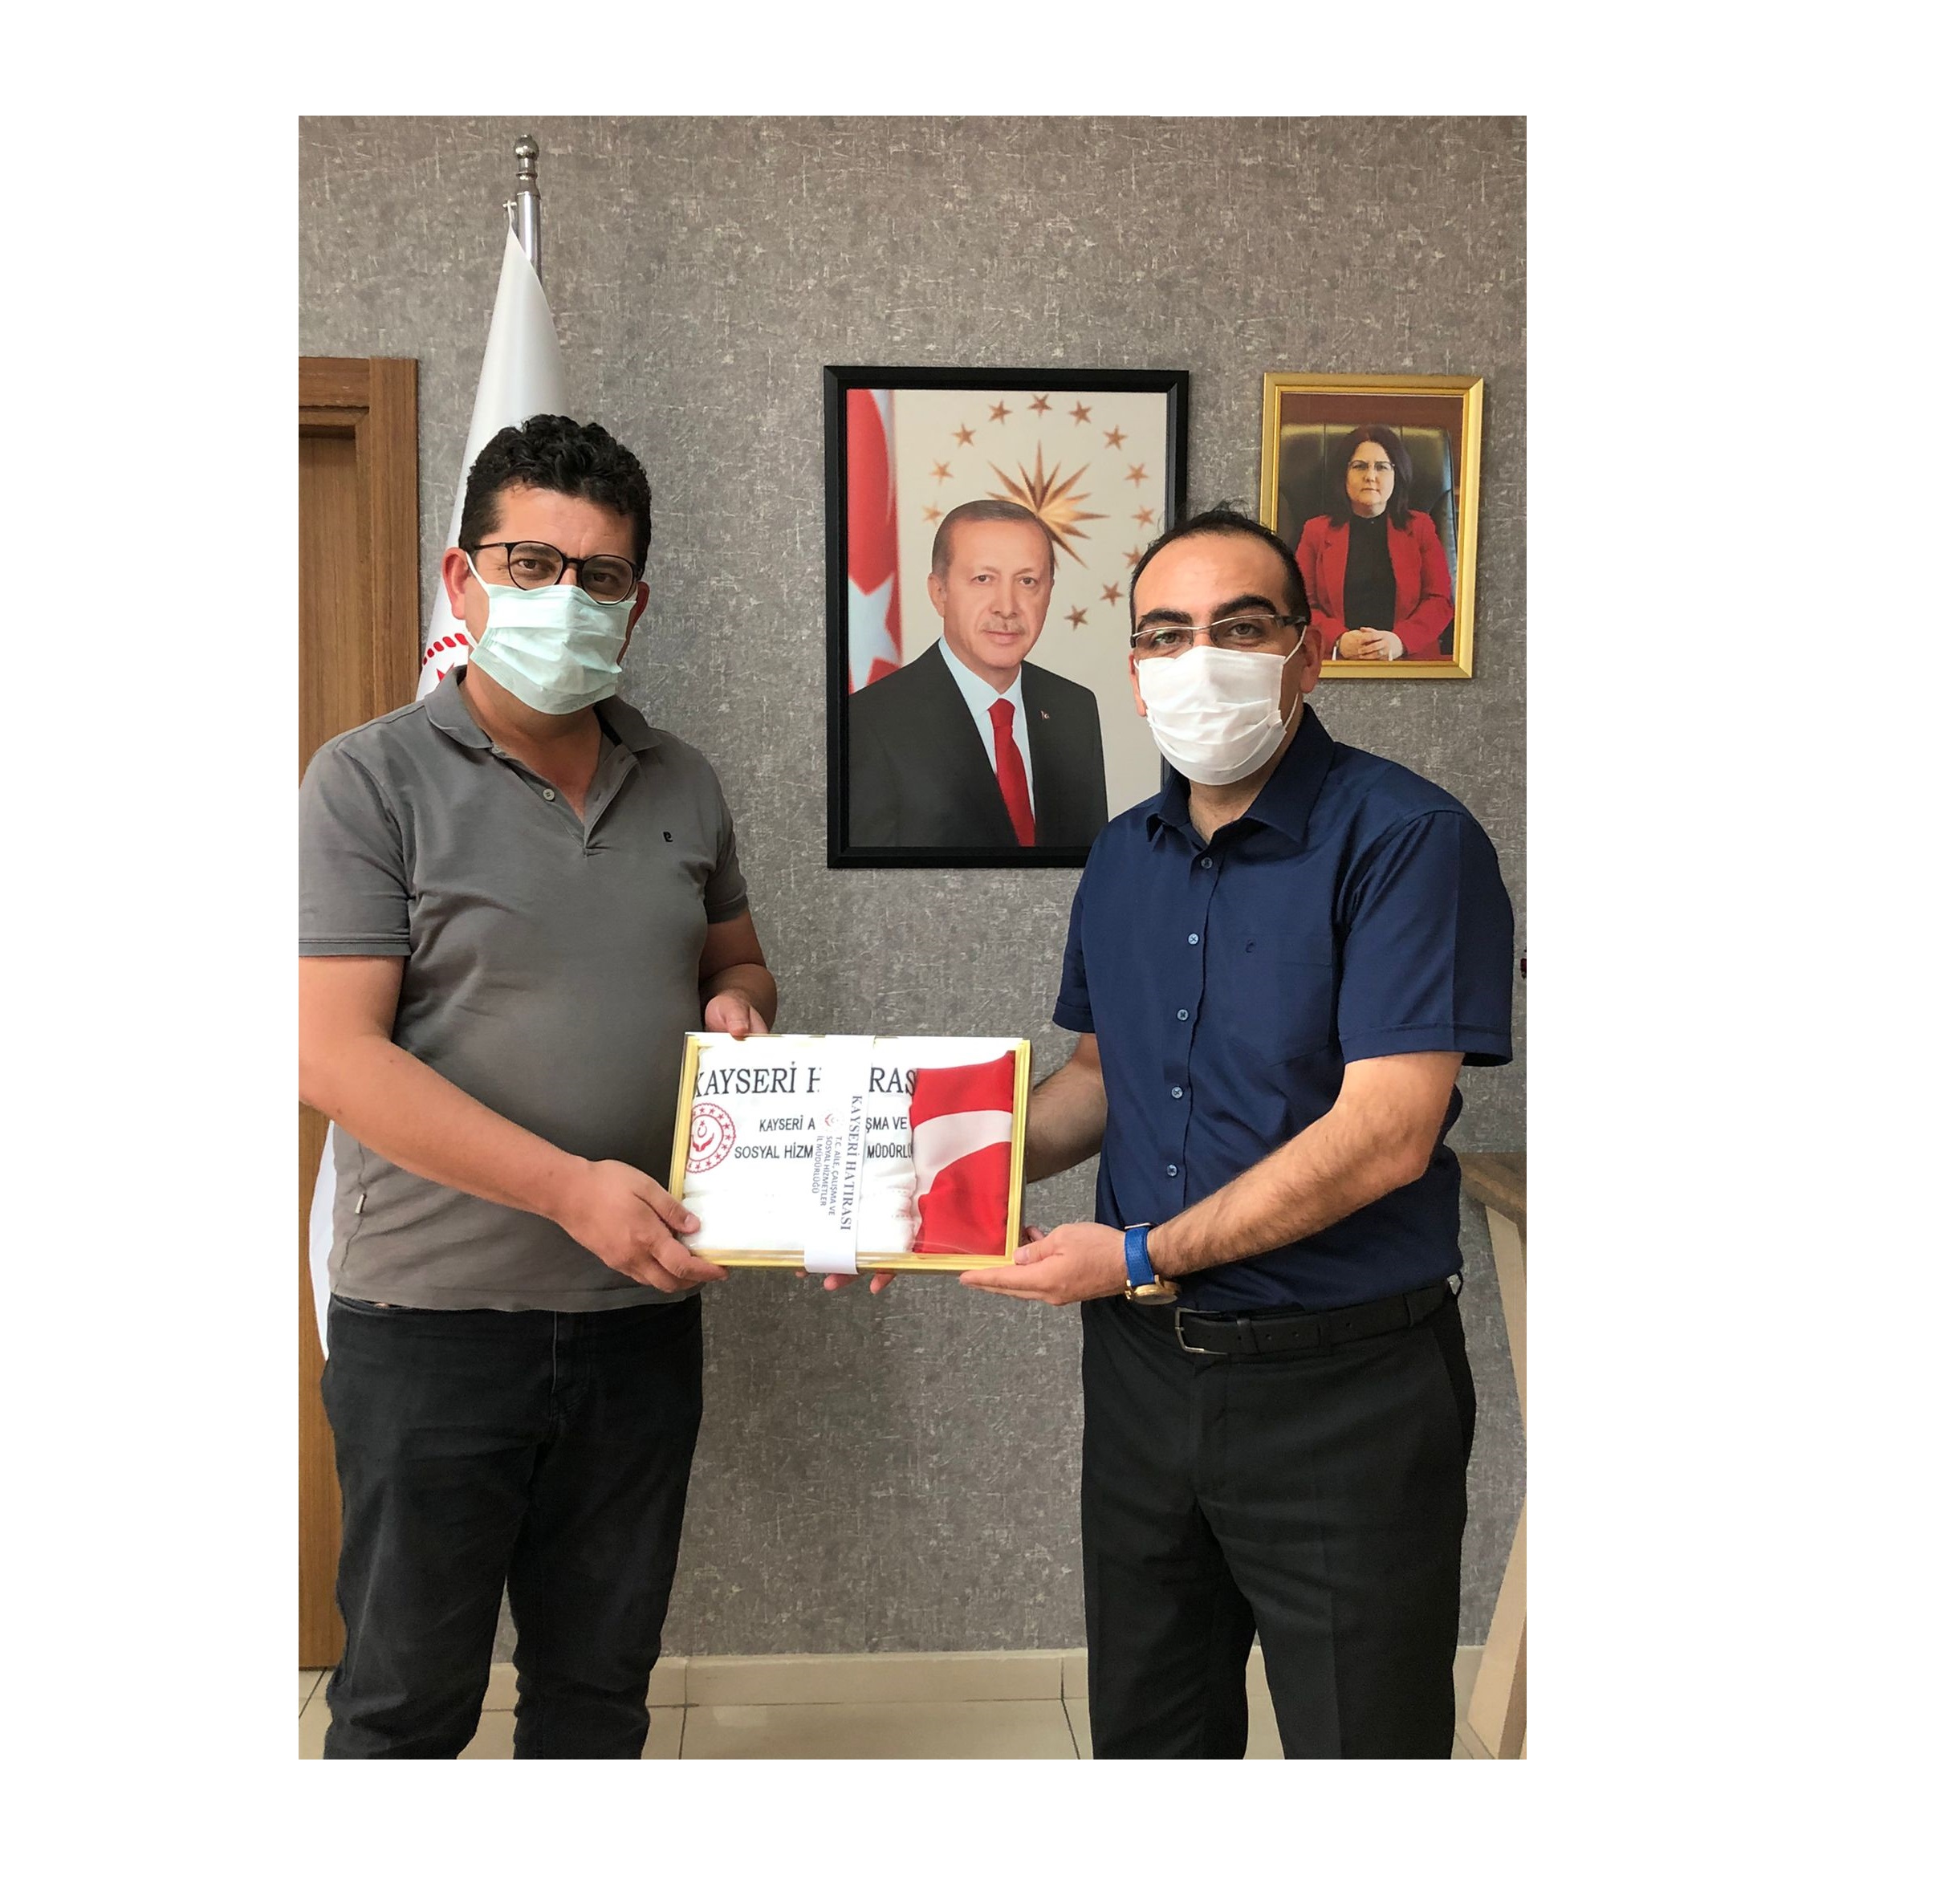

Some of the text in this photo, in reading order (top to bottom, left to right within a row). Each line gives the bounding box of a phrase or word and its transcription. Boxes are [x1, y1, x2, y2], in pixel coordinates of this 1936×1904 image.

[759, 1114, 803, 1132] KAYSERİ
[893, 1117, 907, 1129] VE
[734, 1145, 780, 1158] SOSYAL
[840, 1096, 863, 1230] KAYSERİ HATIRASI
[811, 1144, 823, 1194] MÜDÜRLÜĞÜ
[820, 1136, 833, 1206] SOSYAL HİZMETLER
[830, 1170, 839, 1204] ÇALIŞMA
[828, 1206, 836, 1215] VE
